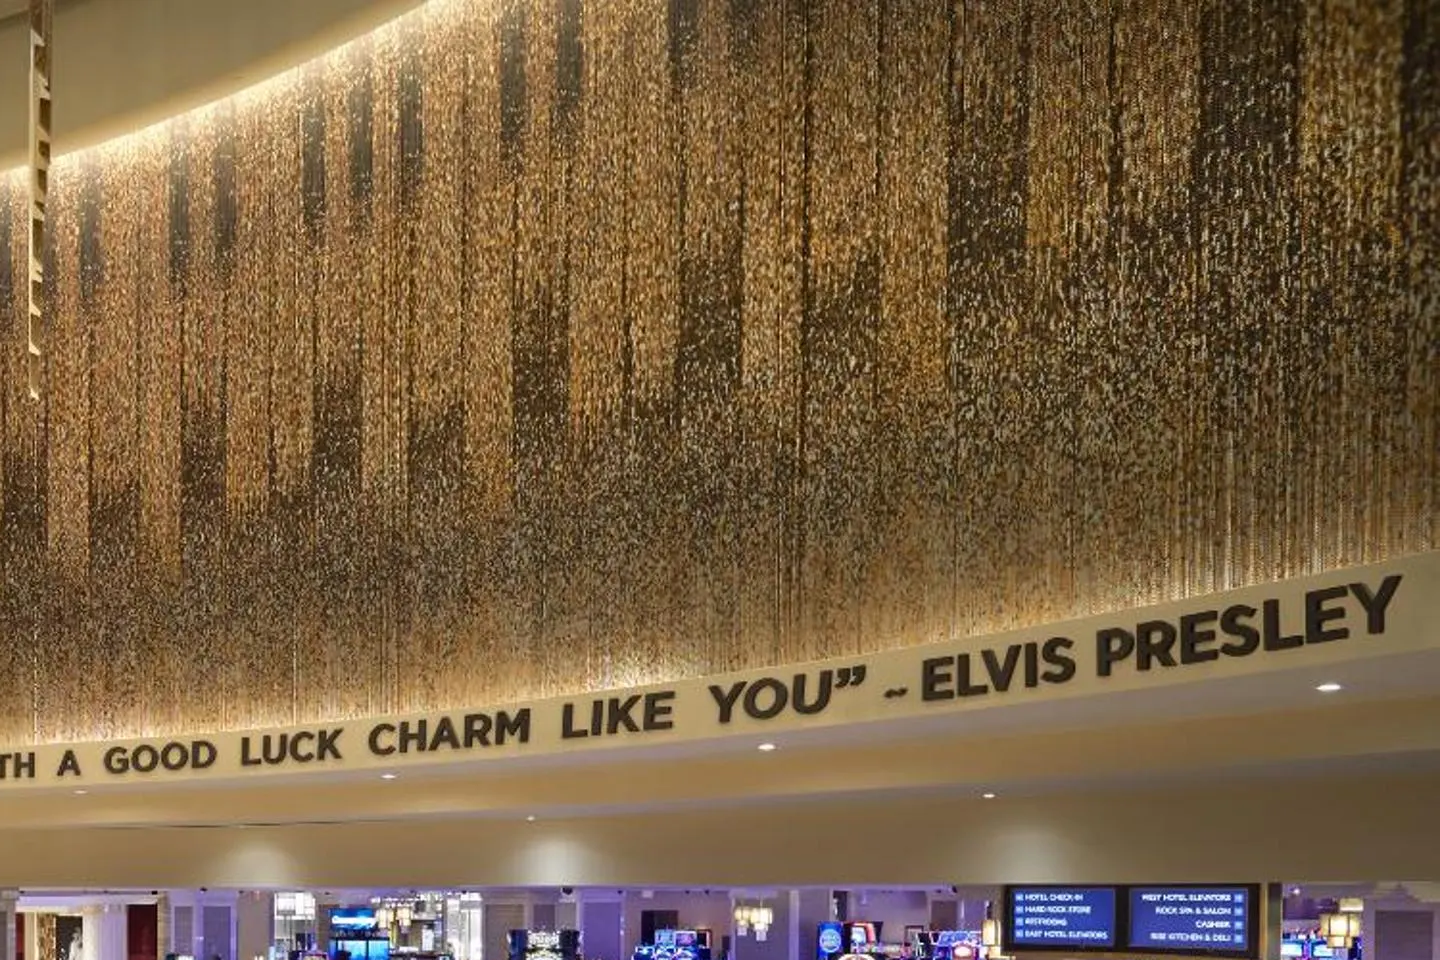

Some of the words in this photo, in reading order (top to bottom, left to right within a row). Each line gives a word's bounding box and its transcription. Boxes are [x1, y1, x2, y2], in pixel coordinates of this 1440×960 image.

[56, 749, 81, 777] A
[103, 740, 218, 775] GOOD
[240, 728, 344, 767] LUCK
[368, 707, 531, 756] CHARM
[561, 690, 676, 740] LIKE
[708, 664, 867, 725] YOU”
[920, 636, 1077, 704] ELVIS
[1095, 573, 1405, 679] PRESLEY
